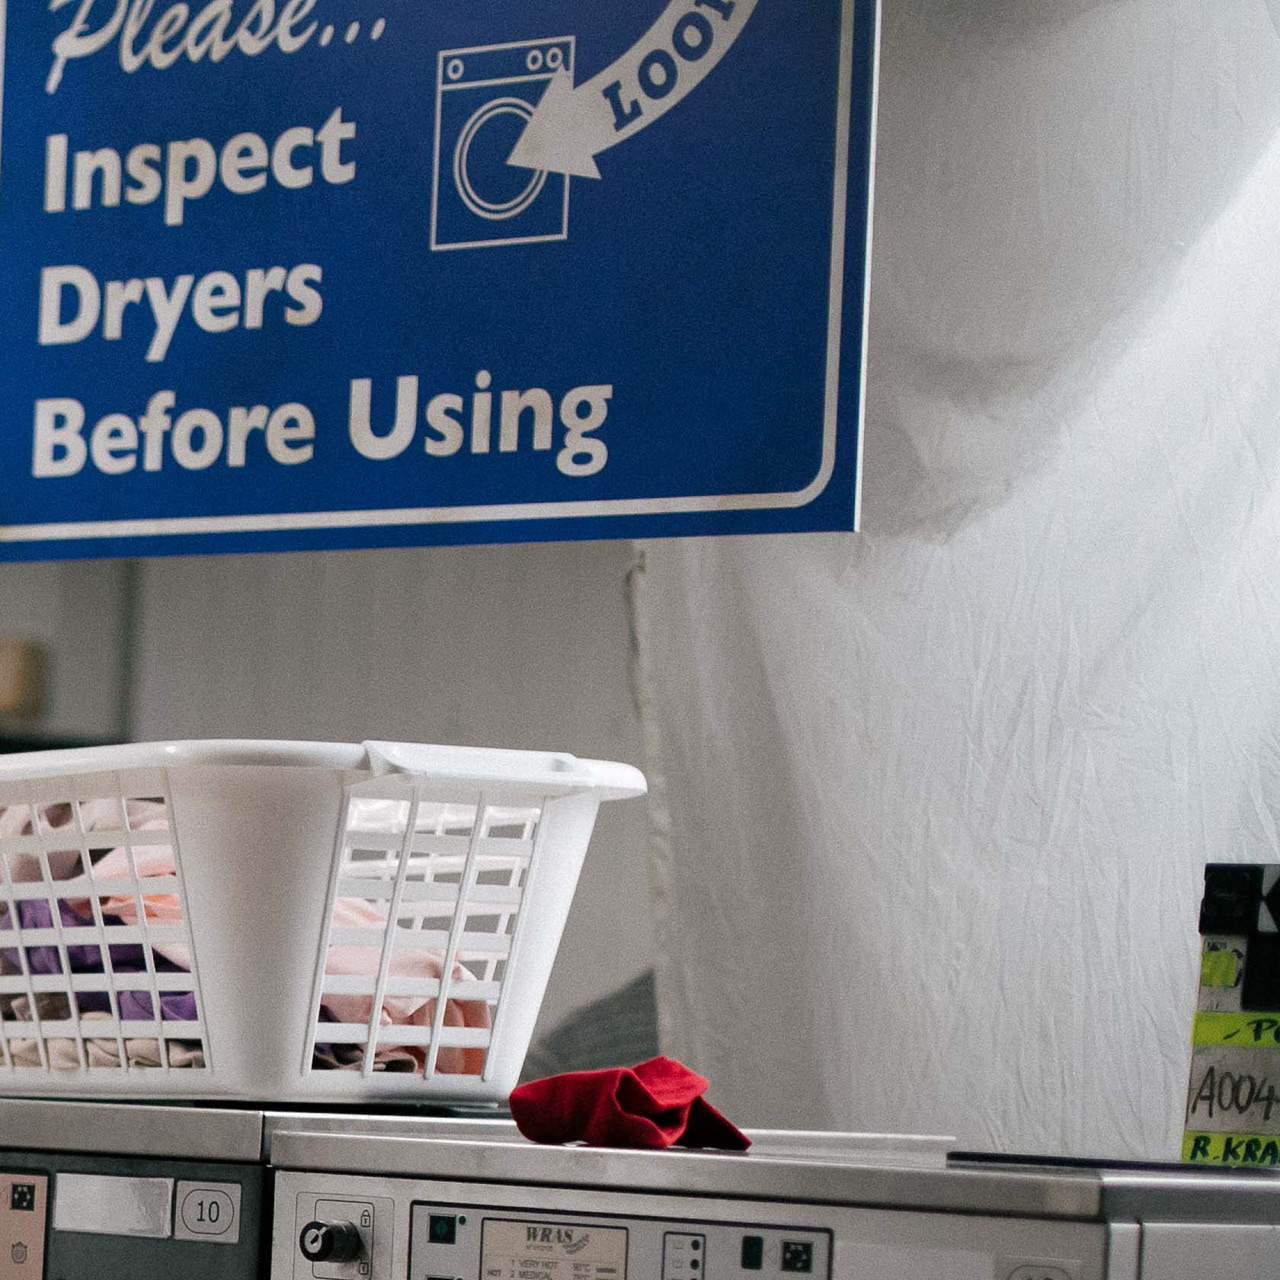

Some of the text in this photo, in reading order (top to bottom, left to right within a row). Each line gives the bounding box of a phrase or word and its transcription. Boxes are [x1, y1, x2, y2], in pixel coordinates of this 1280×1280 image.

[45, 0, 386, 95] Please...
[43, 106, 357, 226] Inspect
[38, 263, 323, 362] Dryers
[32, 369, 614, 478] Before Using
[196, 1200, 220, 1223] 10
[526, 1226, 574, 1243] WRAS
